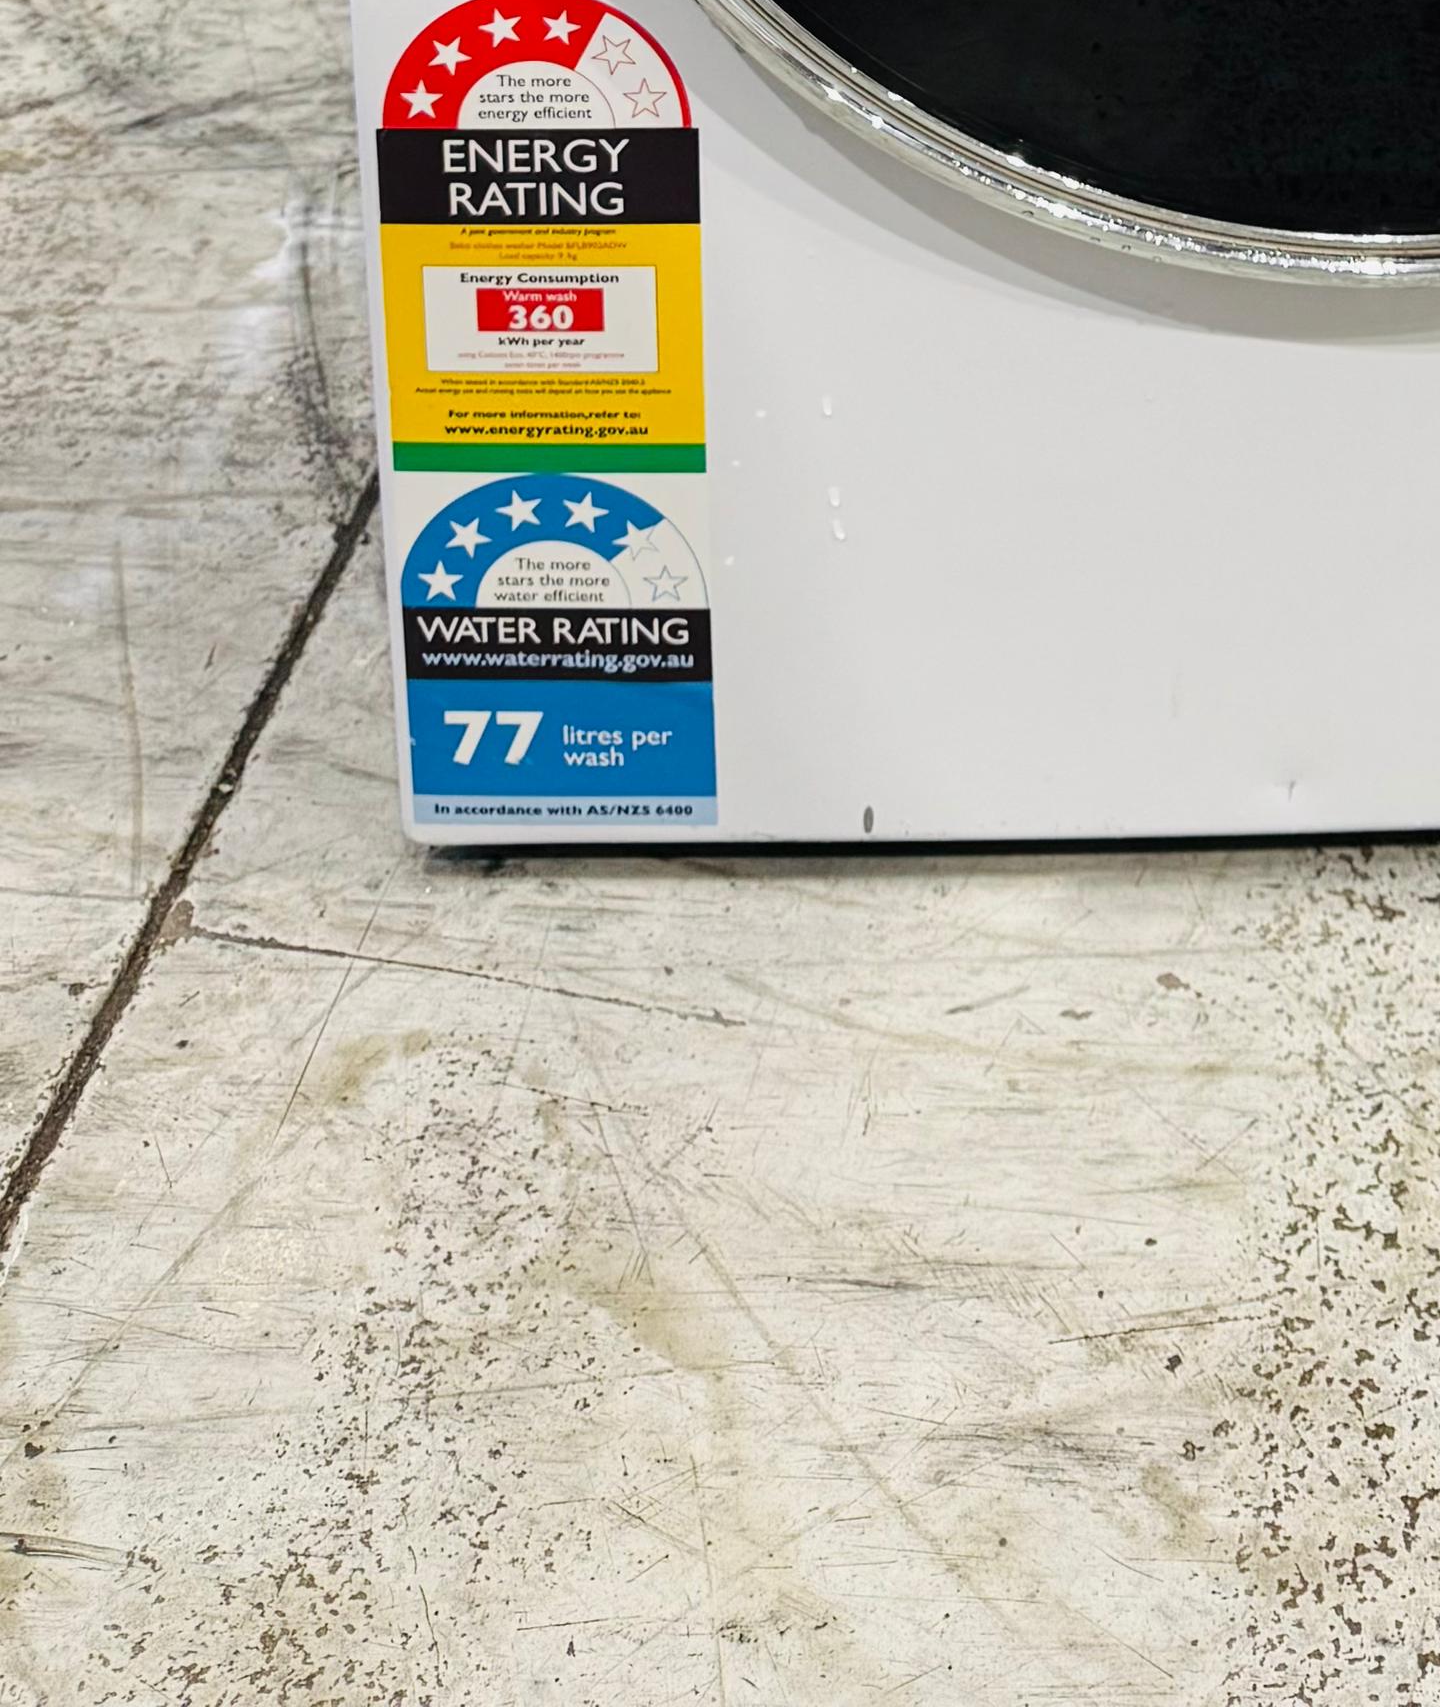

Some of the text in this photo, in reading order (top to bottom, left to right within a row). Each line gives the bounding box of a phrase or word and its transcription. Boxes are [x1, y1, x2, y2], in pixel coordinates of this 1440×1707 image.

[497, 74, 571, 87] The more
[480, 91, 590, 103] stars the more
[478, 106, 592, 123] energy efficient
[442, 139, 630, 174] ENERGY
[449, 182, 625, 216] RATING
[460, 273, 619, 286] Energy Consumption
[502, 290, 577, 302] Warm wash
[508, 305, 574, 330] 360
[498, 337, 584, 348] kWh per year
[449, 410, 469, 418] For
[445, 424, 649, 438] www.energyrating.gov.au
[515, 557, 590, 571] The more
[498, 574, 610, 587] stars the more
[494, 590, 604, 602] water efficient
[417, 616, 690, 645] WATER RATING
[422, 650, 694, 673] www.waterrating.gov.au
[444, 711, 544, 766] 77
[562, 725, 673, 751] litres per
[563, 747, 624, 767] wash
[434, 804, 693, 816] In accordance with AS/NZS 6400
